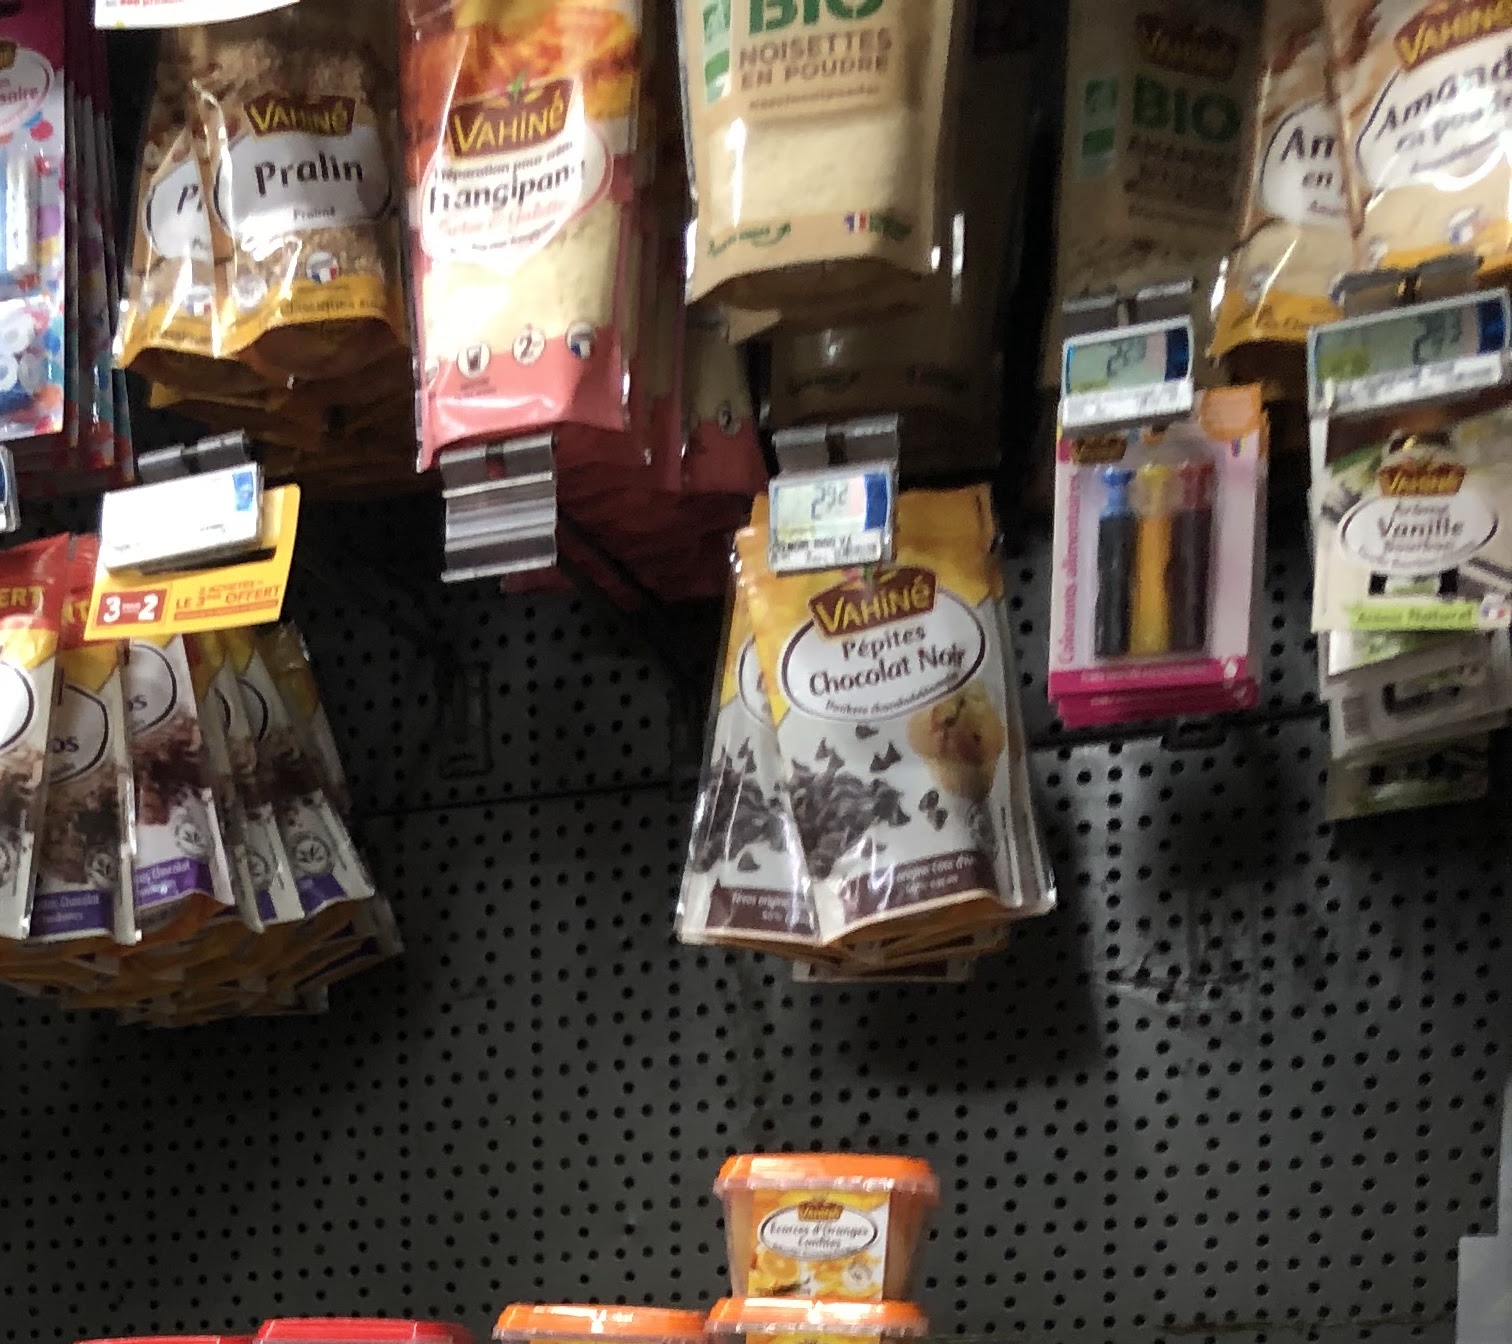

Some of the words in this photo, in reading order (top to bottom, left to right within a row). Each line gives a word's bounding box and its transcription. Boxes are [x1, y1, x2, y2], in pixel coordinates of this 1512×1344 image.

[738, 34, 892, 72] NOISETTES
[740, 68, 776, 88] EN
[782, 53, 892, 86] POUDRE
[454, 93, 565, 149] VAHINÉ
[254, 155, 365, 199] Pralin
[1374, 512, 1465, 541] Vanille
[103, 596, 120, 622] 3
[144, 594, 160, 620] 2
[817, 586, 931, 630] VAHINÉ
[841, 624, 927, 660] Pépites
[808, 657, 911, 698] Chocolat
